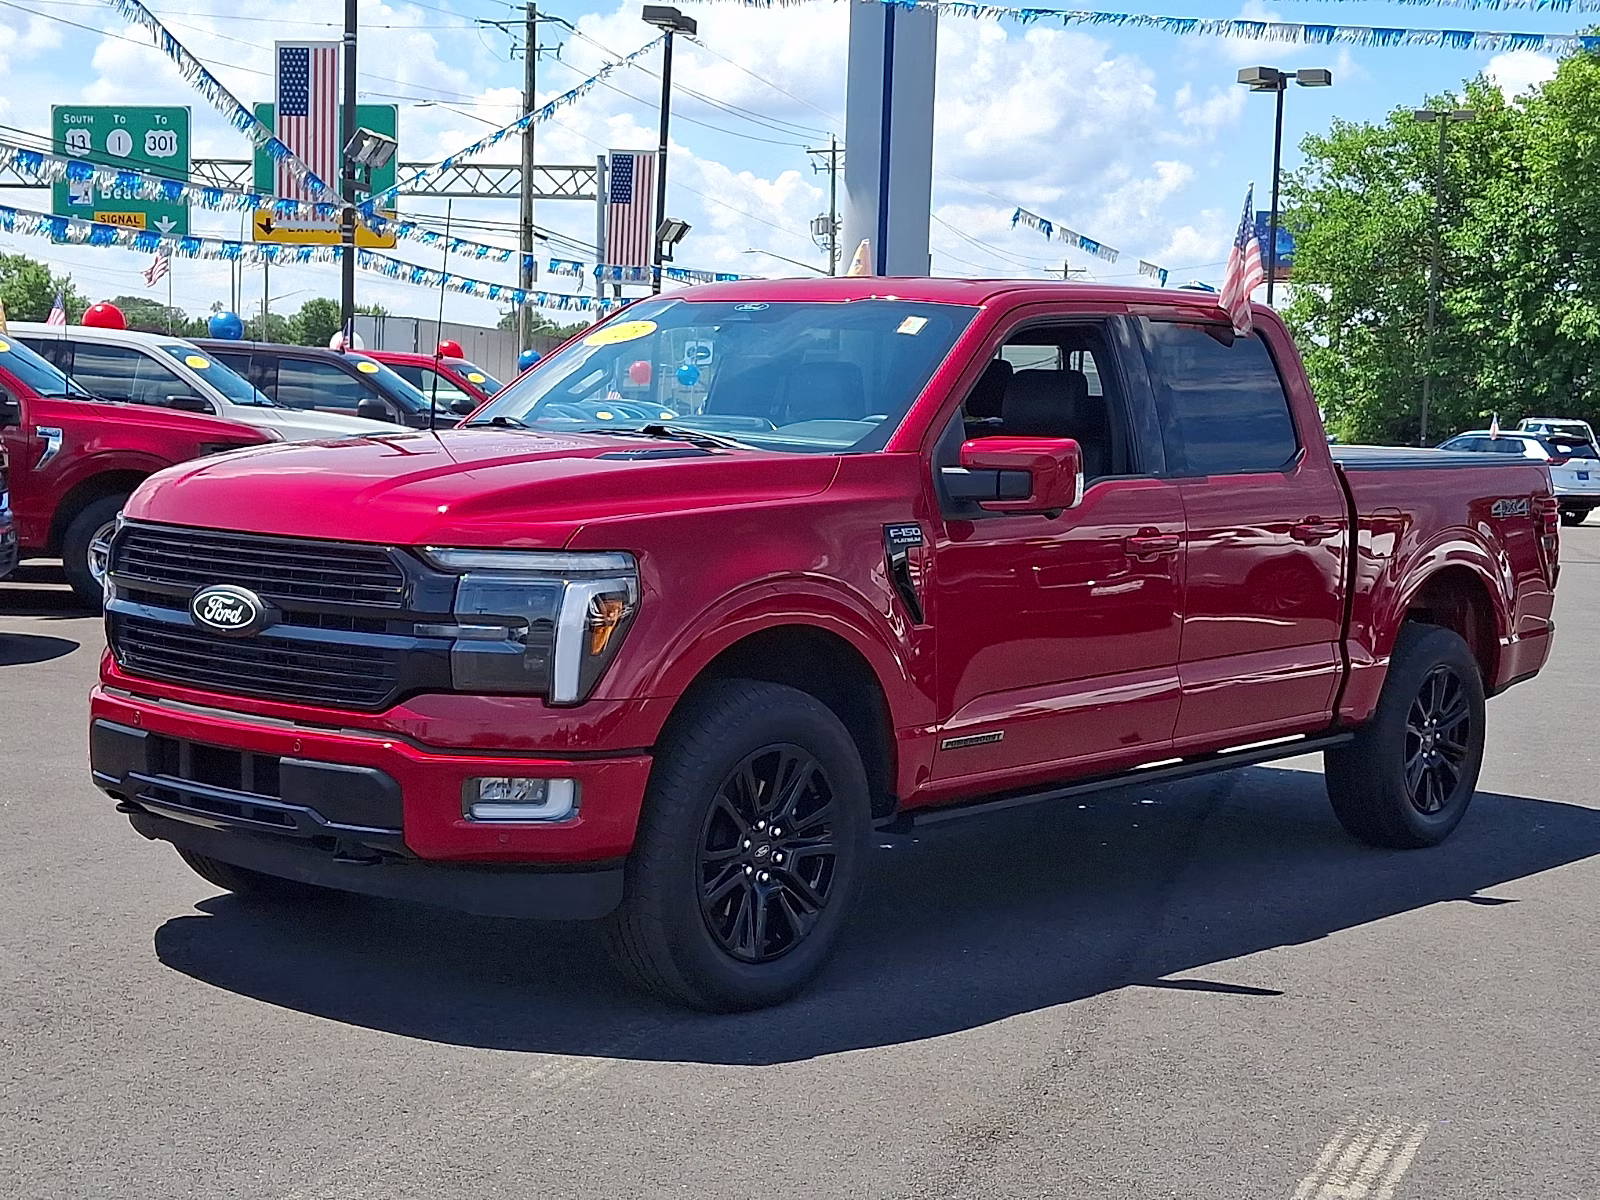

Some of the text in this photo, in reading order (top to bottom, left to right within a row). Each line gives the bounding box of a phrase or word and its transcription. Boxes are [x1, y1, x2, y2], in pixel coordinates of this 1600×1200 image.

[63, 114, 94, 124] SOUTH
[71, 134, 86, 150] 13
[148, 136, 174, 151] 301
[100, 214, 140, 224] SIGNAL
[890, 528, 921, 537] F-150
[204, 595, 244, 624] Ford
